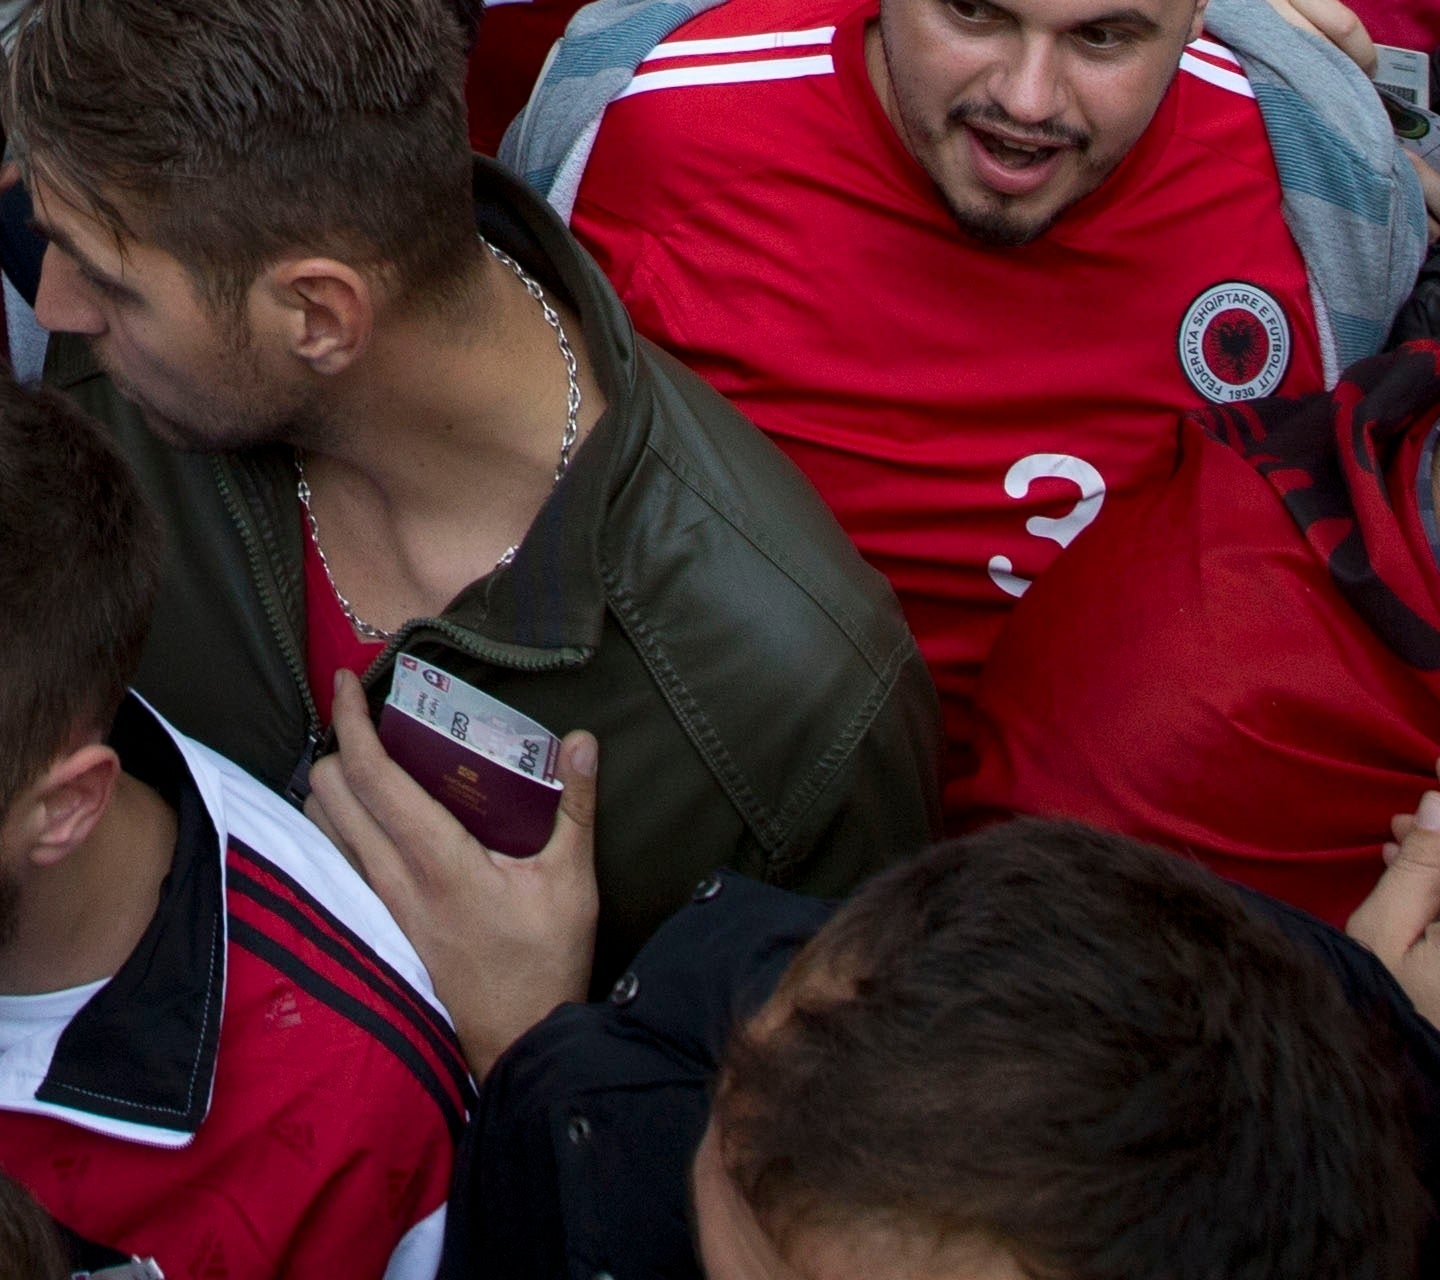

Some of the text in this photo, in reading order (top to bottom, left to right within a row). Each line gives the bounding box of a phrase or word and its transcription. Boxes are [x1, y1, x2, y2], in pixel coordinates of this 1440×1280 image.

[1187, 292, 1283, 396] FEDERATA SHQIPTARE E FUTBOLLIT
[1228, 386, 1256, 400] 1930
